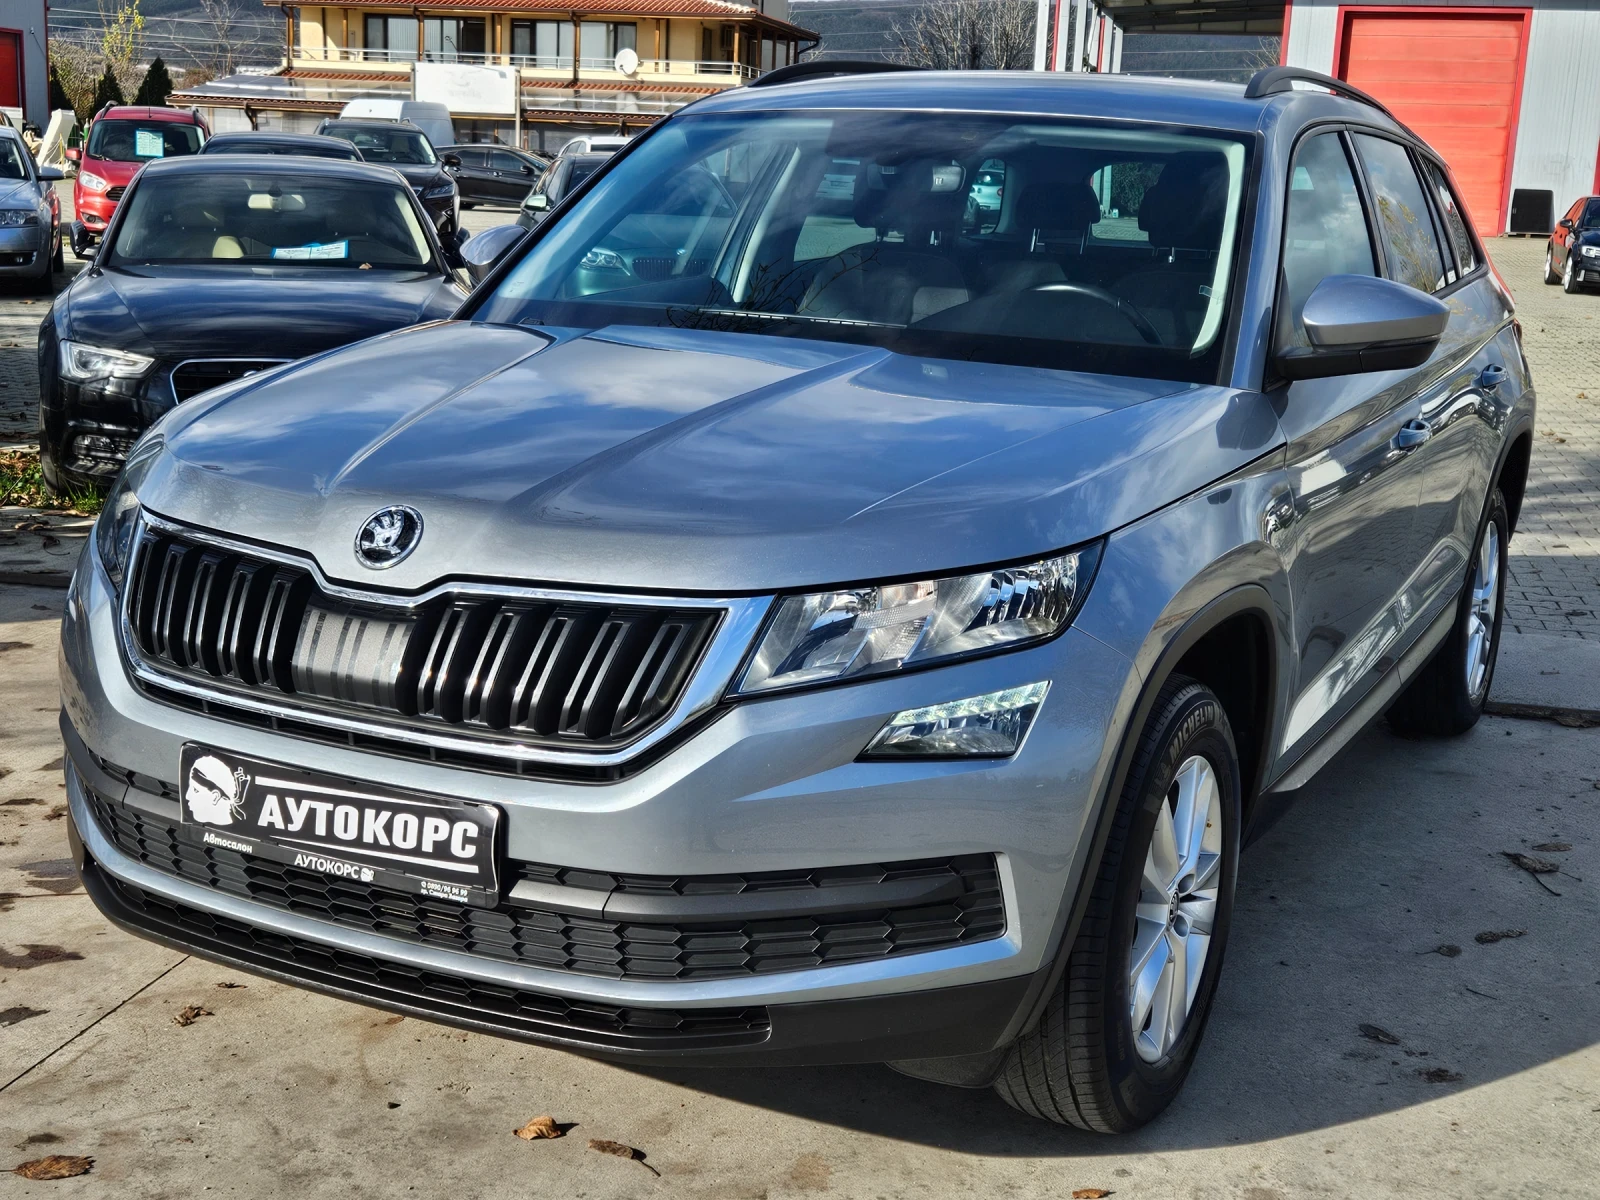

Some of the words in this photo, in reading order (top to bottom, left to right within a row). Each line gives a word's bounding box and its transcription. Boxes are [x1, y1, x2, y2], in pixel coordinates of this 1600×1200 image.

[1168, 705, 1214, 765] MICHELIN
[202, 831, 253, 854] Автосалон
[257, 794, 480, 859] АУТОКОРС
[293, 853, 360, 878] АУТОКОРС
